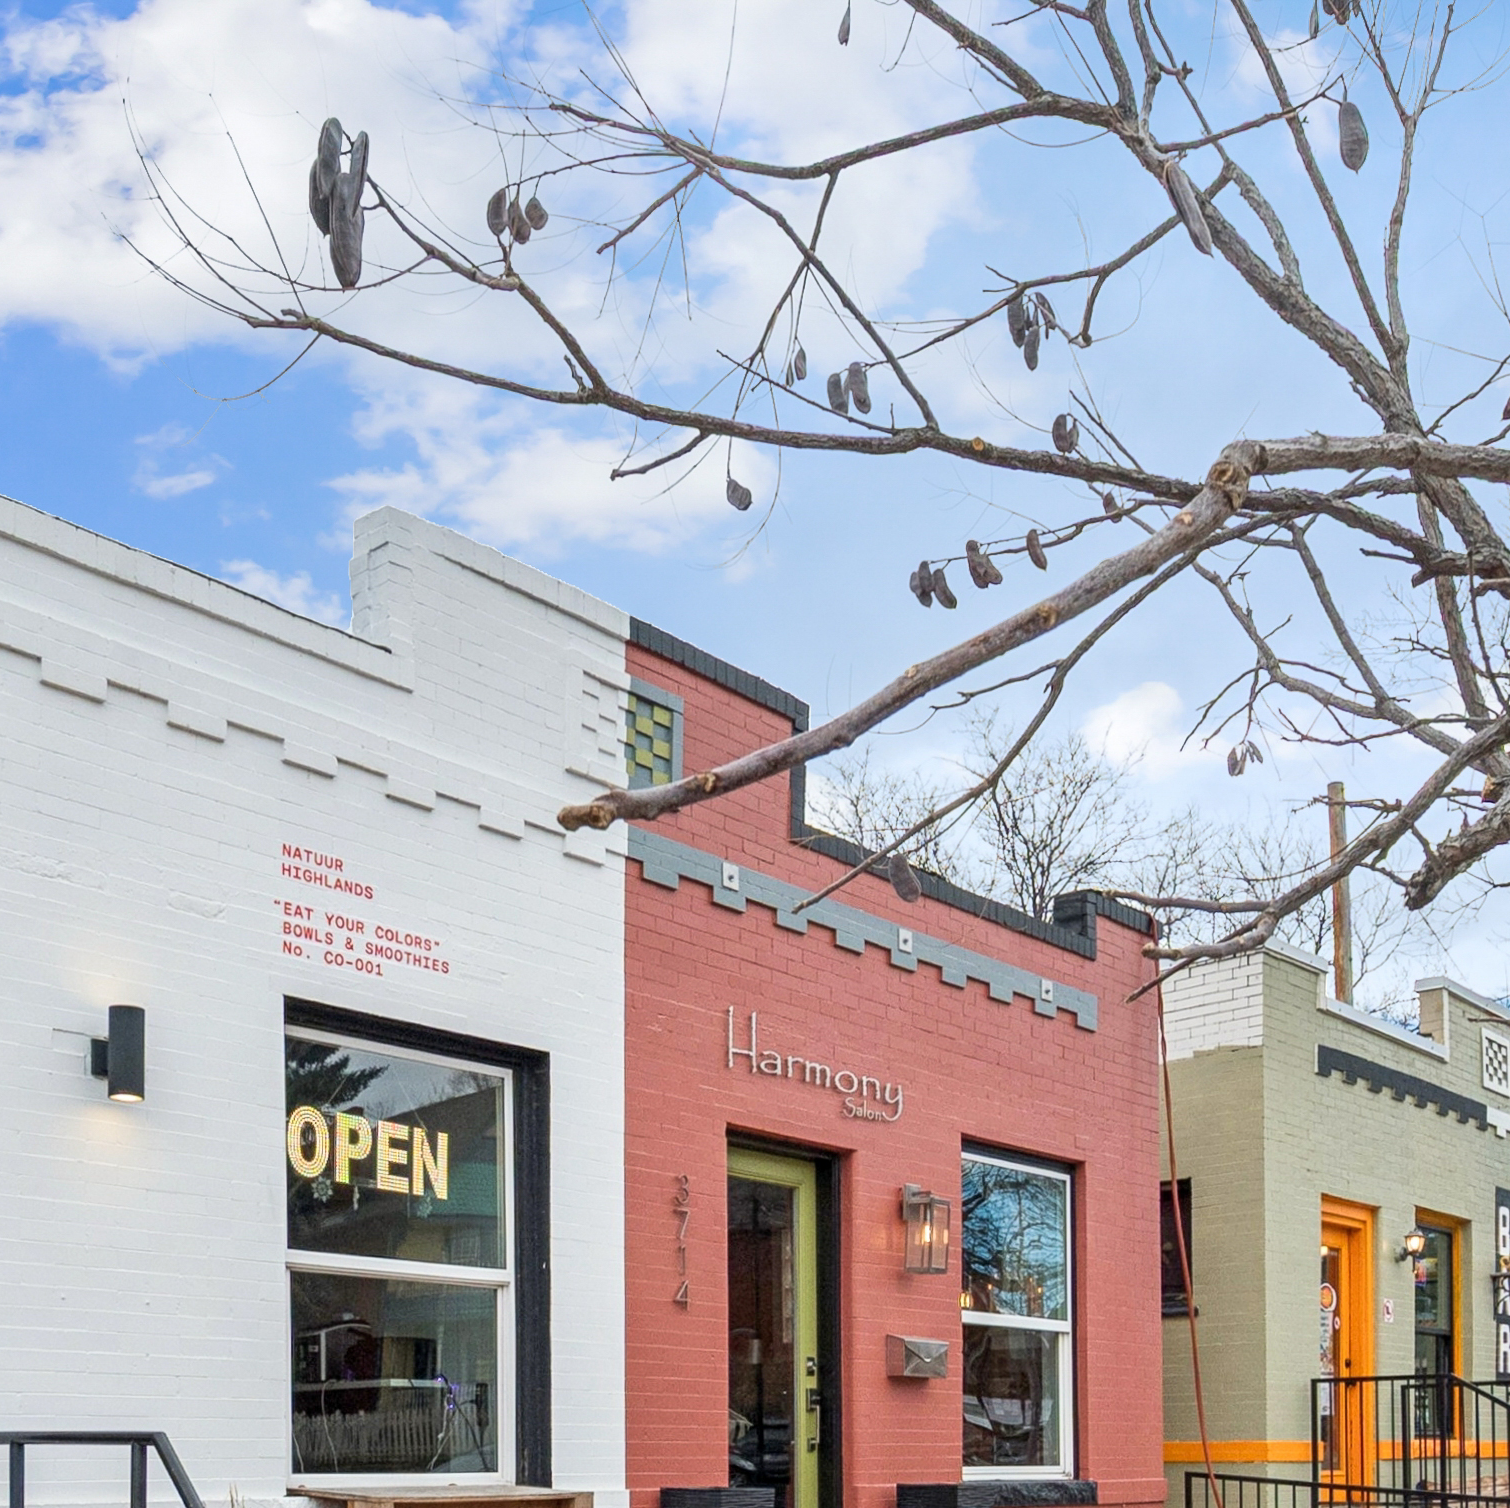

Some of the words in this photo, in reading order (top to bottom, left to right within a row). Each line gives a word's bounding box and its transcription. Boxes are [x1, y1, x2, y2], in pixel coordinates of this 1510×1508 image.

[281, 842, 344, 873] NATUUR
[281, 862, 374, 900] HIGHLANDS
[325, 911, 365, 935] YOUR
[282, 921, 334, 946] BOWLS
[344, 936, 355, 951] &
[364, 941, 451, 975] SMOOTHIES
[282, 940, 312, 960] No.
[323, 950, 384, 977] CO-001
[727, 1005, 903, 1121] Harmony
[842, 1097, 884, 1122] Salon
[287, 1104, 449, 1201] OPEN
[673, 1172, 691, 1312] 3714
